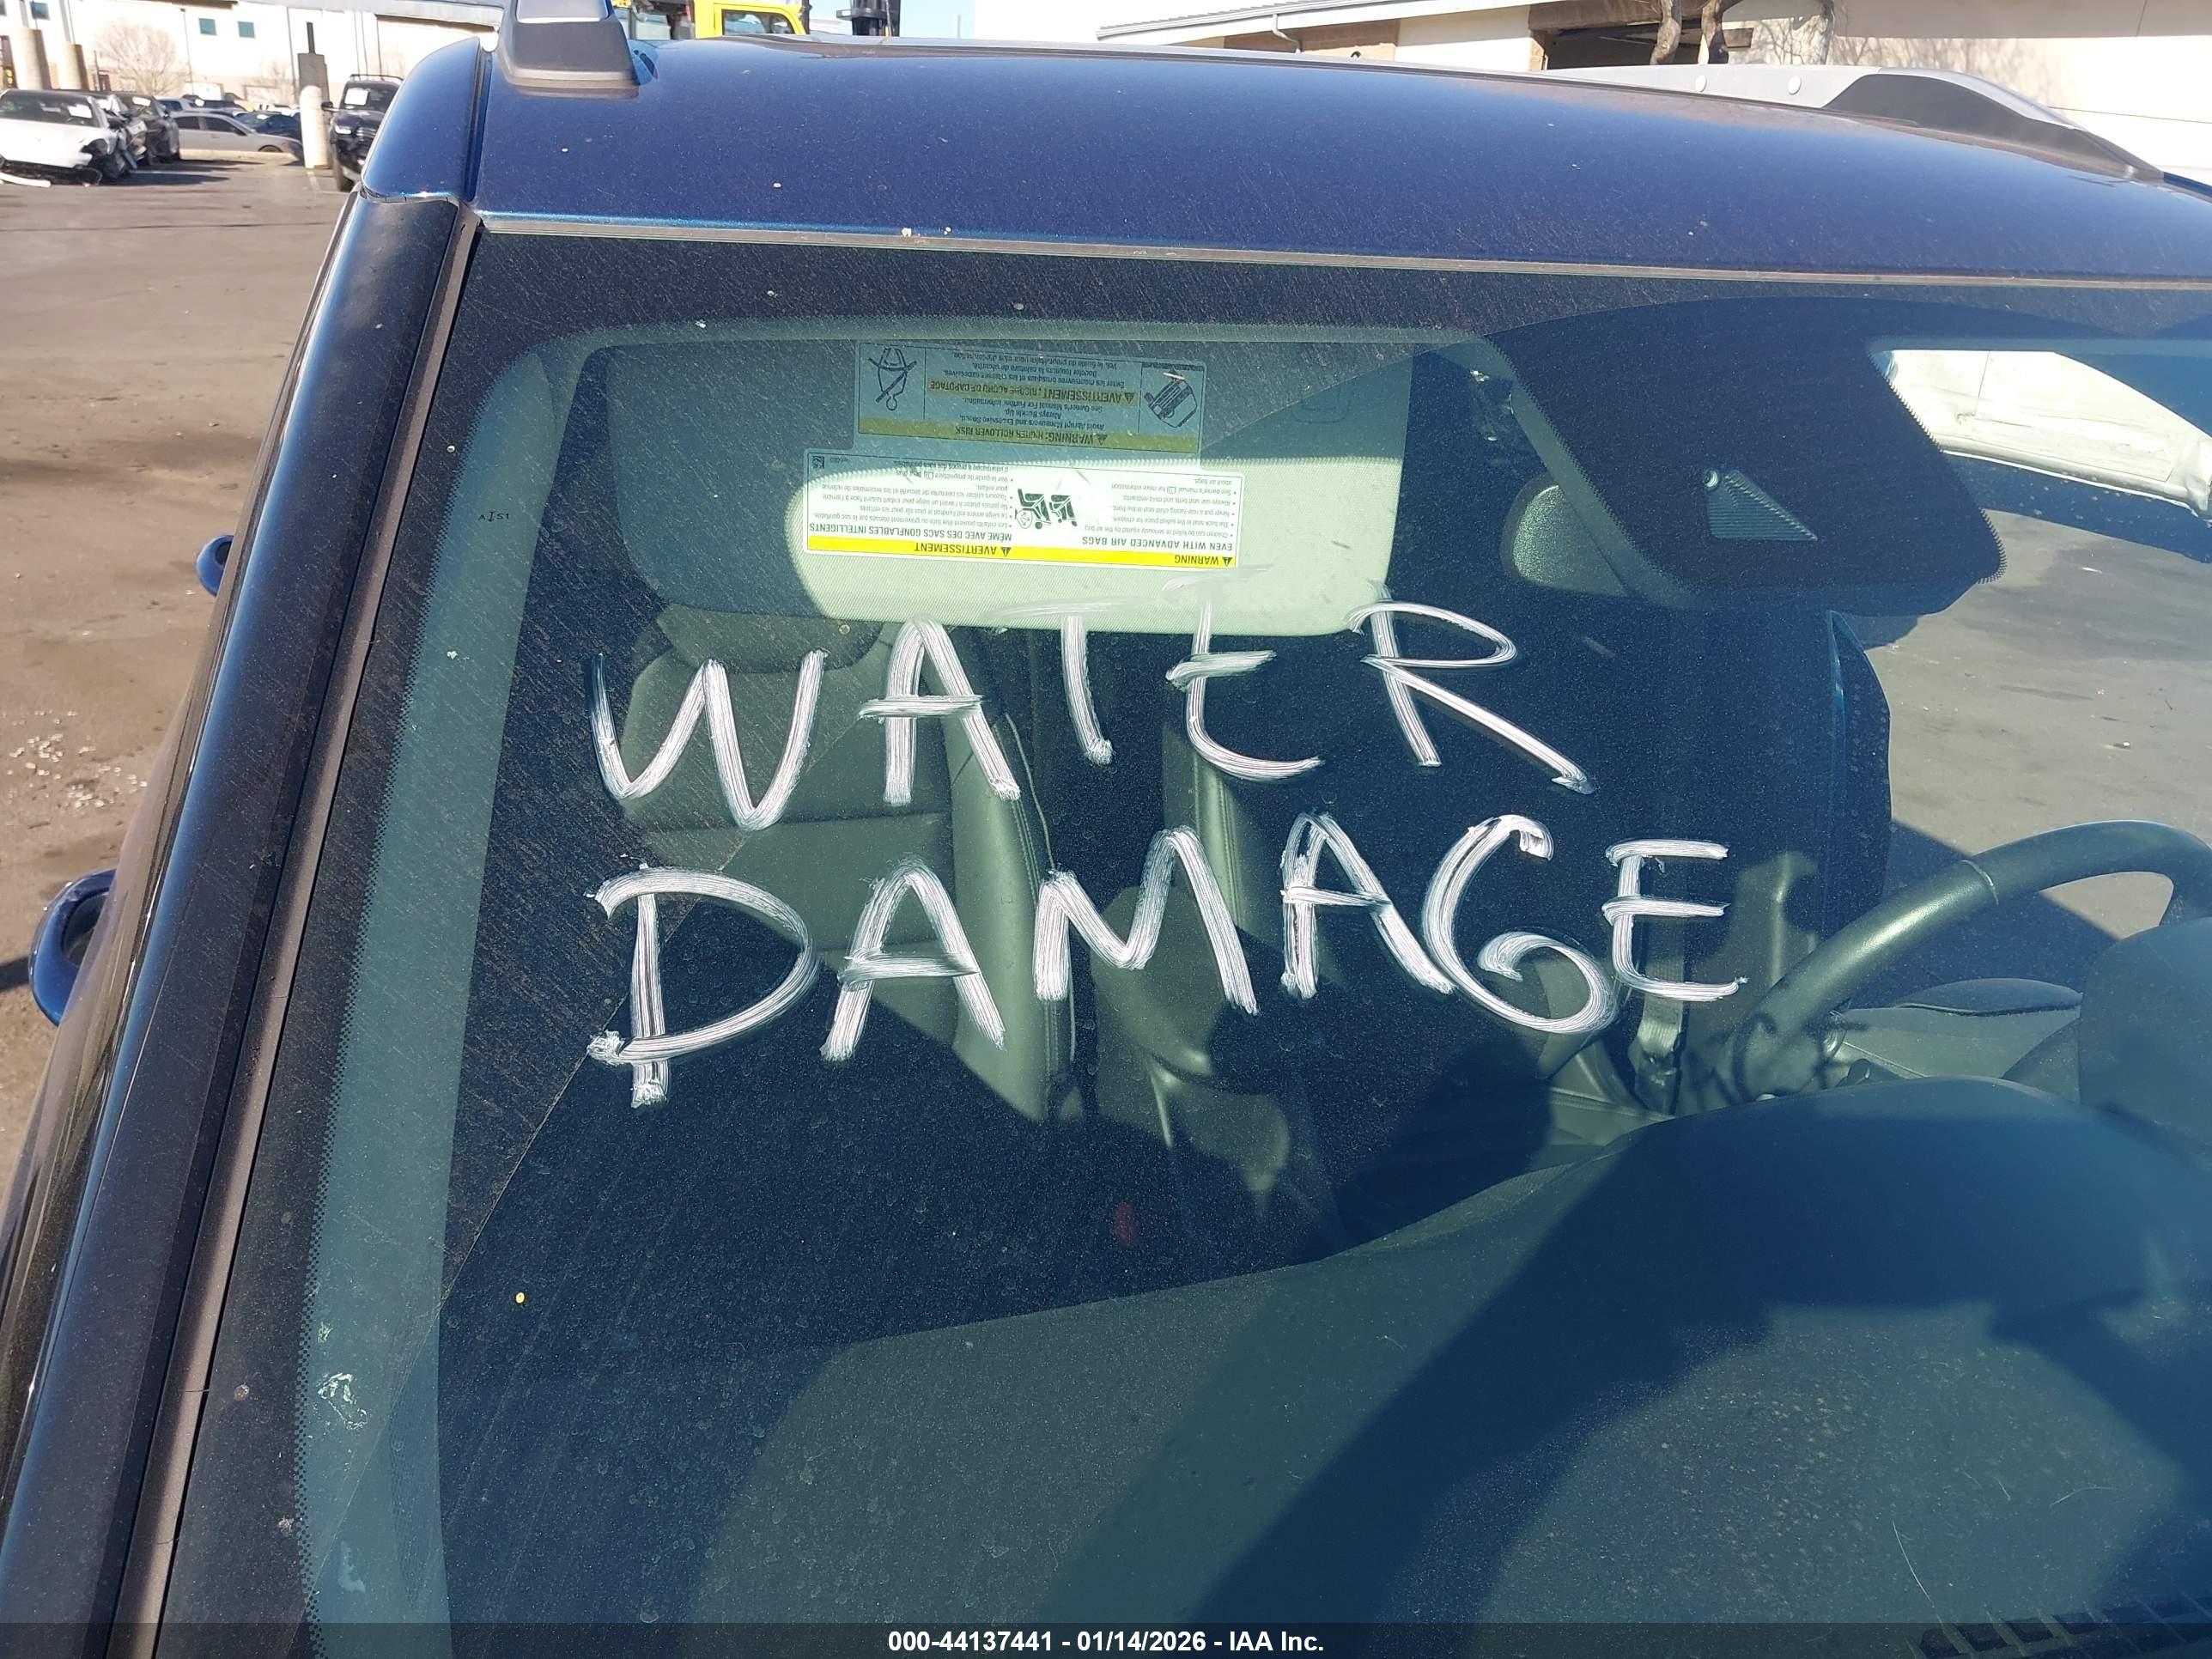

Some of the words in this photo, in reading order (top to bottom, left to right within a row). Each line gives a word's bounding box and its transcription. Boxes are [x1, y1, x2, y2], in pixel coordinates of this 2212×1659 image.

[929, 381, 969, 394] CAPOTAGE
[954, 426, 973, 437] RISK
[975, 428, 1013, 440] ROLLOVER
[1044, 431, 1093, 444] WARNING:
[809, 523, 866, 534] INTELLIGENTS
[868, 526, 921, 537] GONFLABLES
[923, 529, 945, 538] SACS
[946, 530, 962, 538] DES
[964, 531, 985, 539] AVEC
[987, 532, 1012, 543] MÊME
[1081, 536, 1107, 545] BAGS
[1110, 538, 1126, 546] AIR
[1130, 538, 1180, 549] ADVANCED
[1182, 541, 1206, 550] WITH
[1209, 542, 1232, 550] EVEN
[914, 542, 997, 555] AVERTISSEMENT
[1174, 554, 1218, 565] WARNING
[589, 570, 1596, 830] WATER
[586, 810, 1747, 1108] DAMAGE
